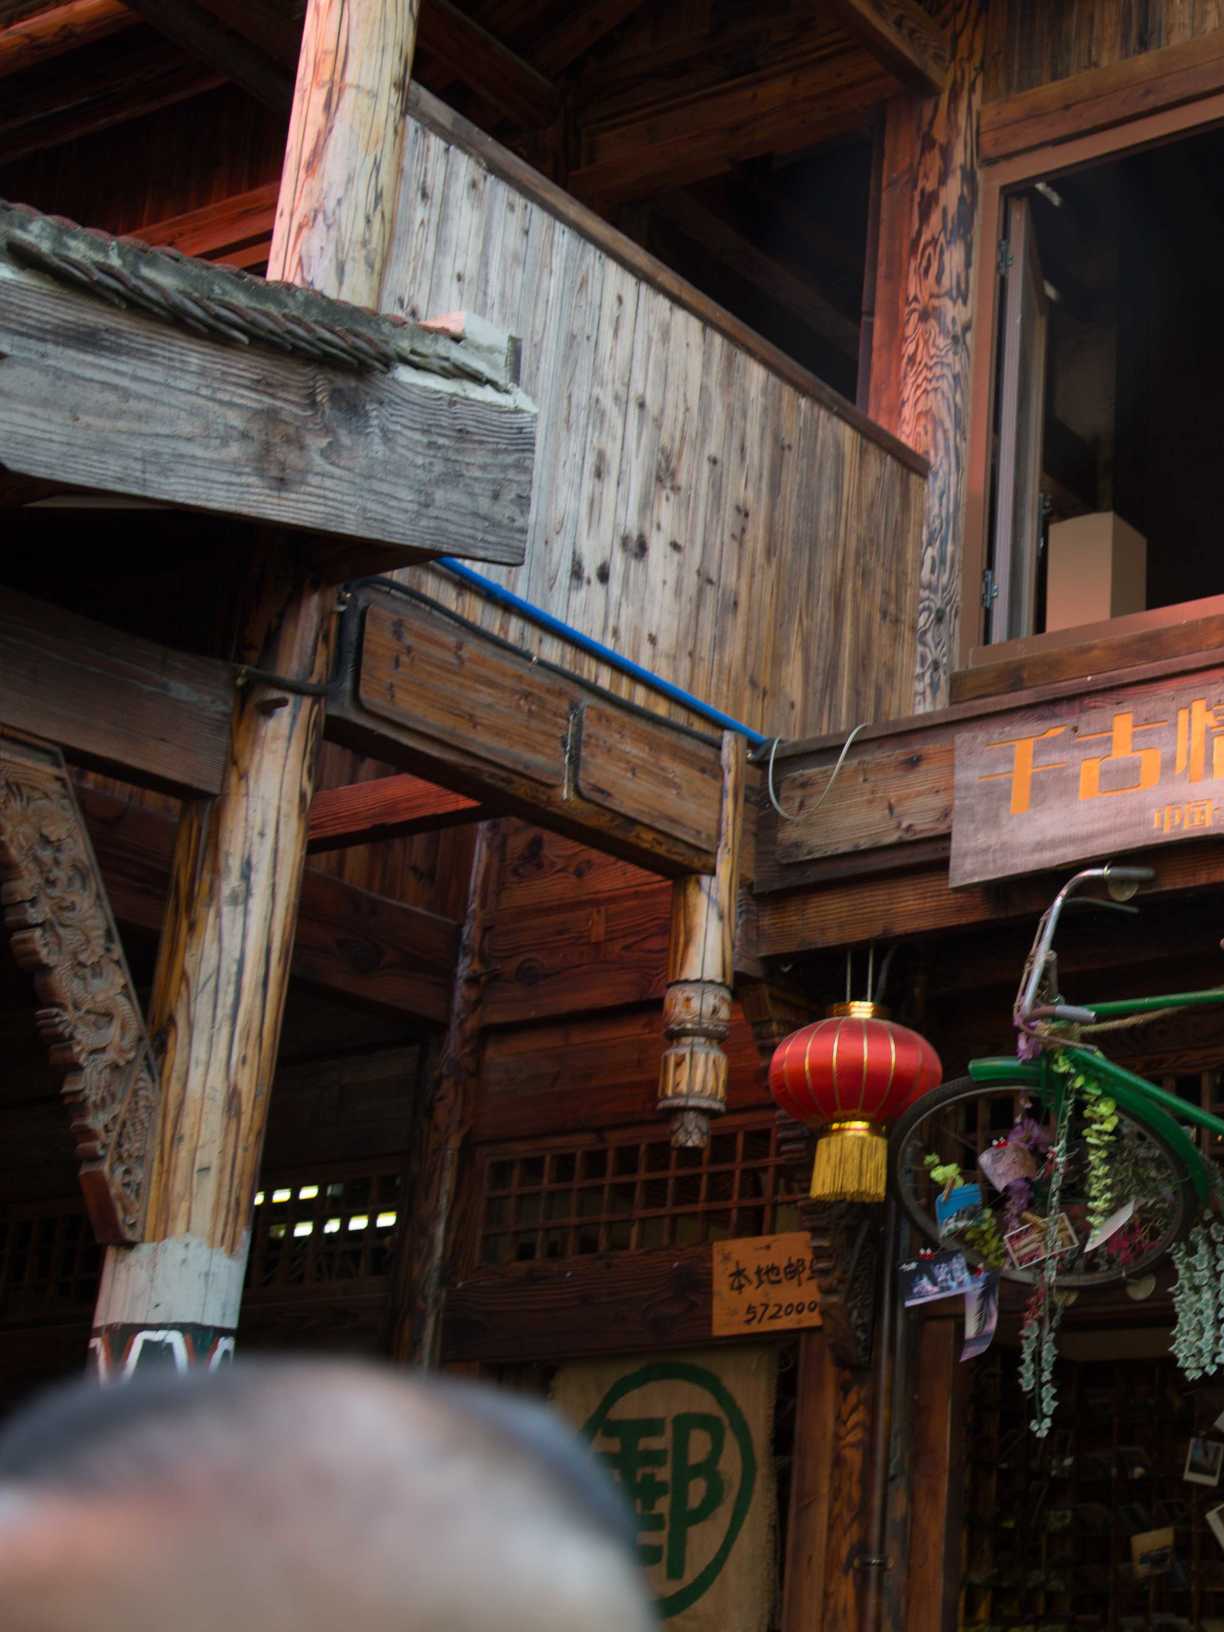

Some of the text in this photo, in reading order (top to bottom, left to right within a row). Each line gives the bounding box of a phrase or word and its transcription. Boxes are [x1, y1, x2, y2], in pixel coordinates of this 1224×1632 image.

[728, 1256, 816, 1294] 本地邮
[744, 1300, 818, 1324] 572000
